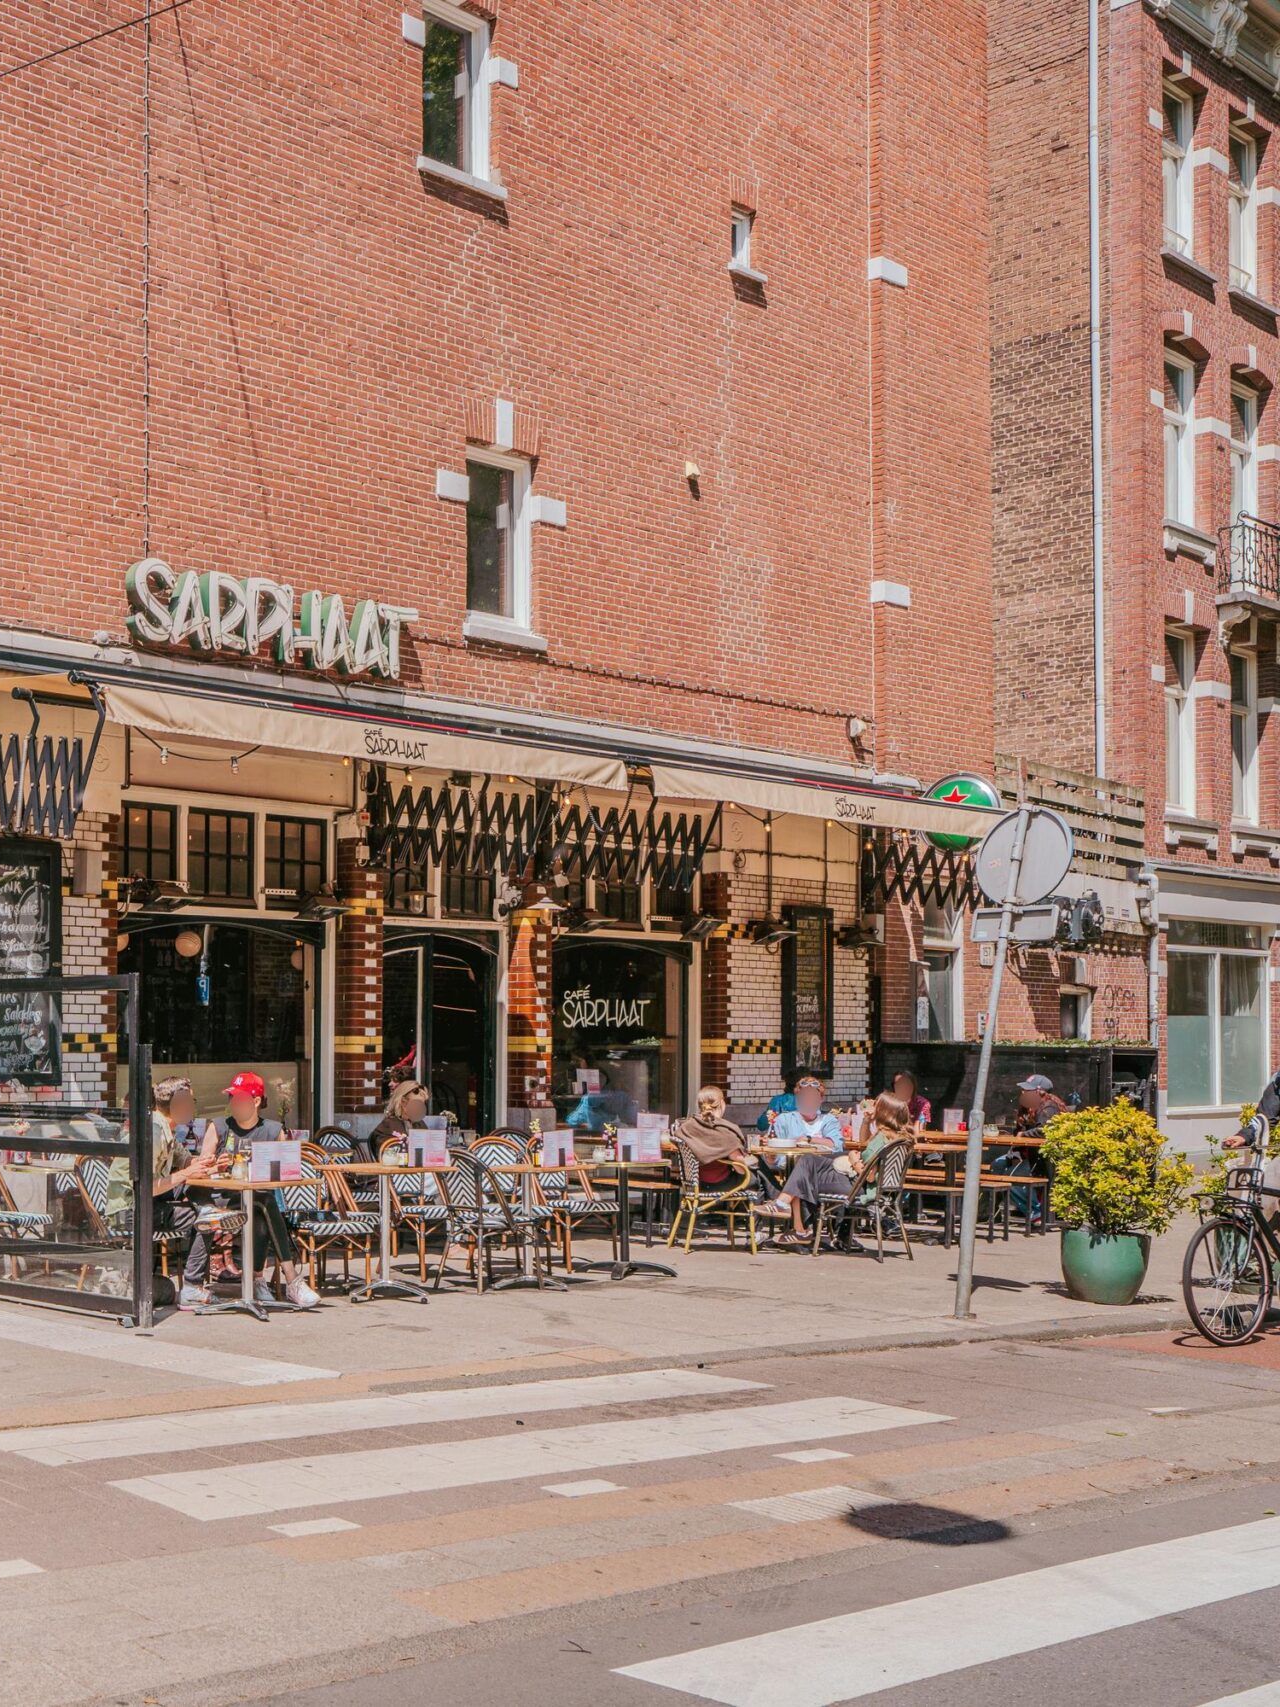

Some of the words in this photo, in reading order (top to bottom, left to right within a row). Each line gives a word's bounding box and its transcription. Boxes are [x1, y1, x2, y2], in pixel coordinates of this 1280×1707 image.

[126, 558, 419, 680] SARPHAAT
[365, 736, 428, 760] SARPHAAT
[563, 984, 591, 1000] CAFÉ
[562, 998, 651, 1028] SARPHAAT
